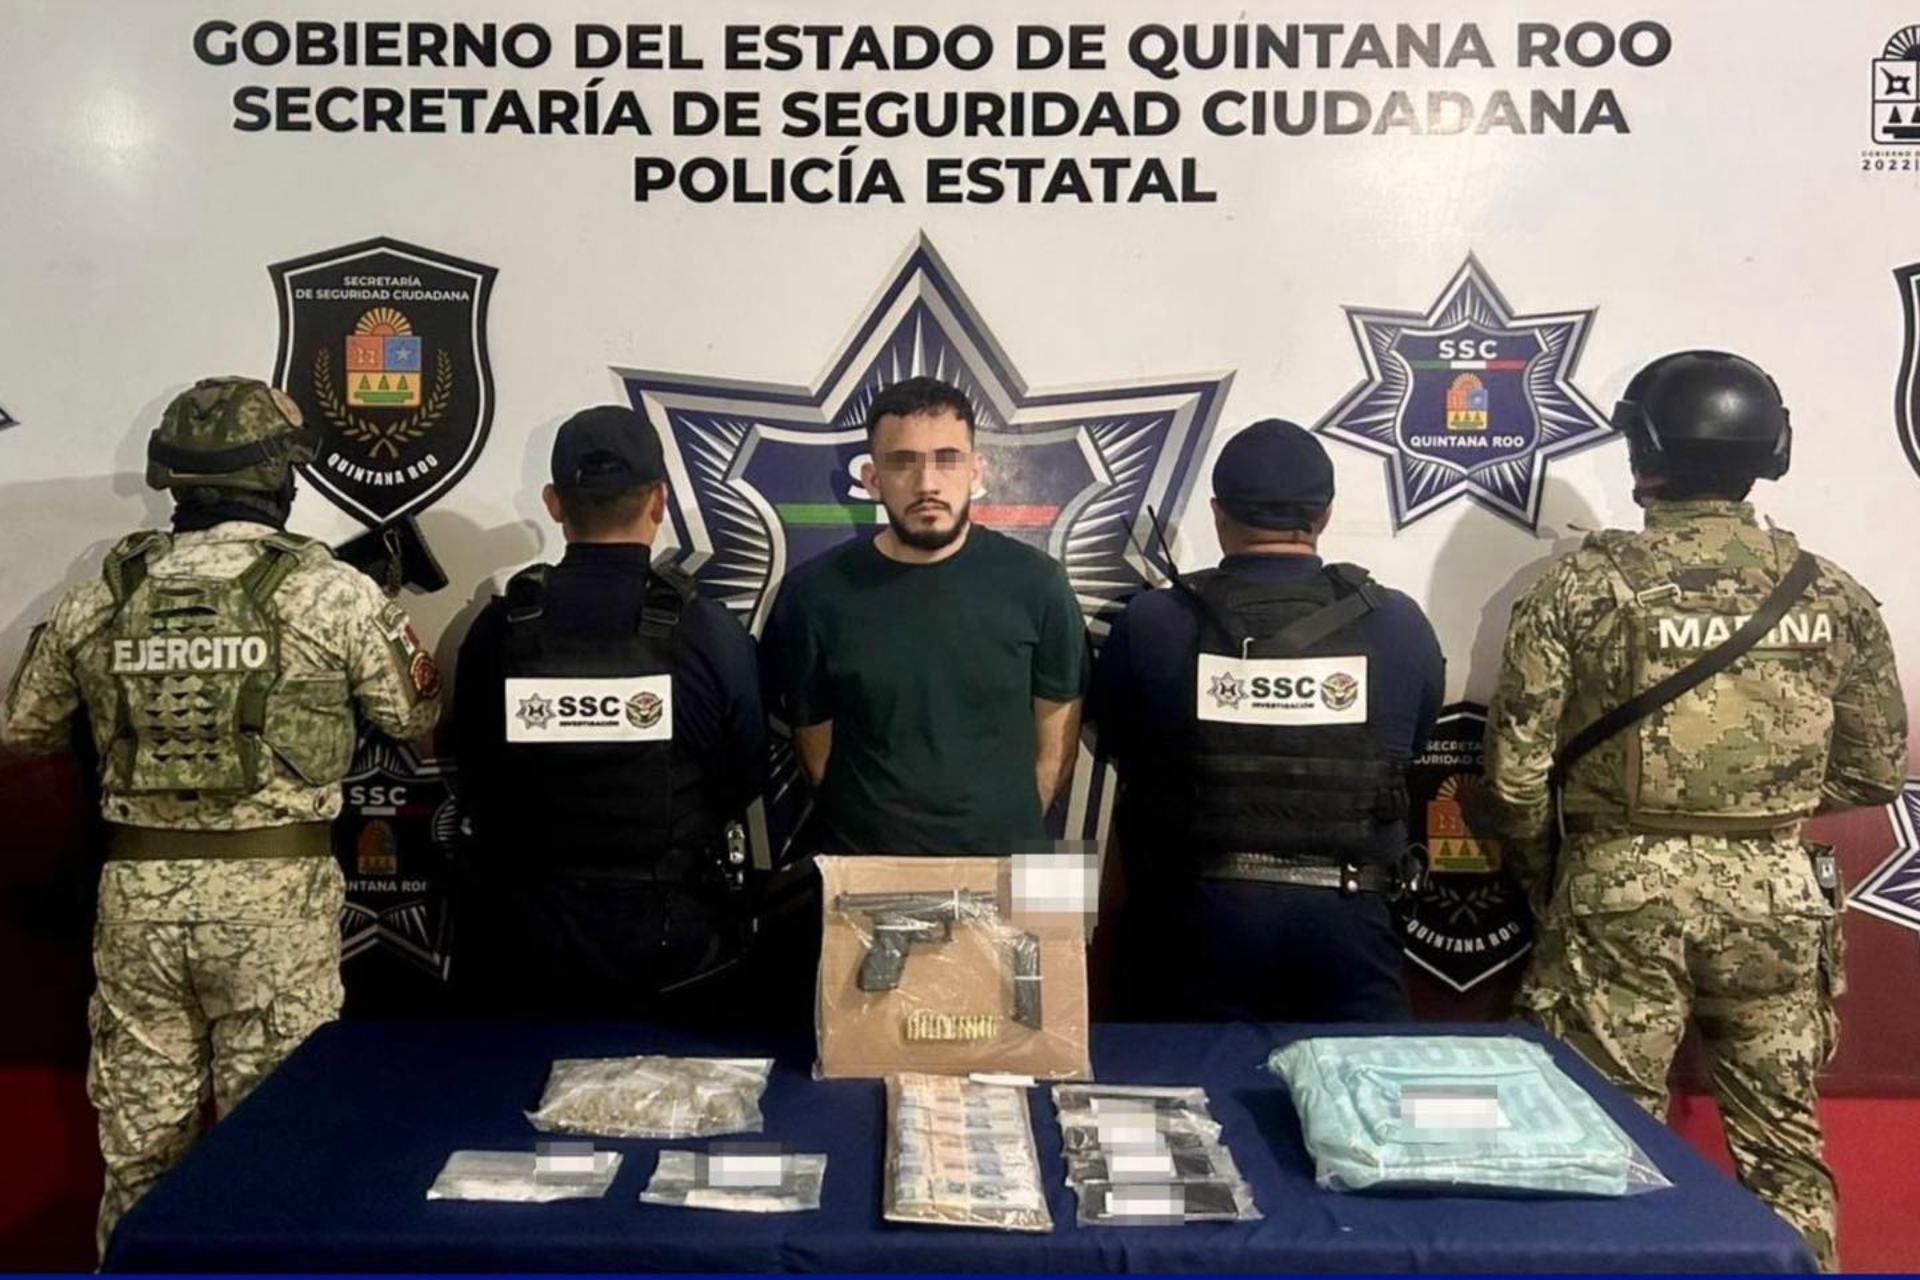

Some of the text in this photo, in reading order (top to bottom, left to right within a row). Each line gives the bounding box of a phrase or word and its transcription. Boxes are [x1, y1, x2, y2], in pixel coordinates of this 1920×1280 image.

[193, 20, 552, 69] GOBIERNO
[575, 24, 704, 70] DEL
[725, 24, 993, 71] ESTADO
[1017, 24, 1106, 70] DE
[1519, 20, 1672, 68] ROO
[232, 79, 1631, 138] SECRETARÍA DE SEGURIDAD CIUDADANA
[635, 146, 1217, 204] POLICÍA ESTATAL
[343, 275, 422, 287] SECRETARÍA
[295, 288, 470, 301] DE SEGURIDAD CIUDADANA
[1439, 339, 1498, 359] SSC
[1410, 435, 1525, 449] QUINTANA ROO
[327, 453, 439, 485] QUINTANA ROO
[113, 635, 268, 671] EJÉRCITO
[1251, 677, 1316, 699] SSC
[558, 696, 620, 717] SSC
[350, 786, 407, 805] SSC
[1406, 919, 1485, 953] QUINTANA
